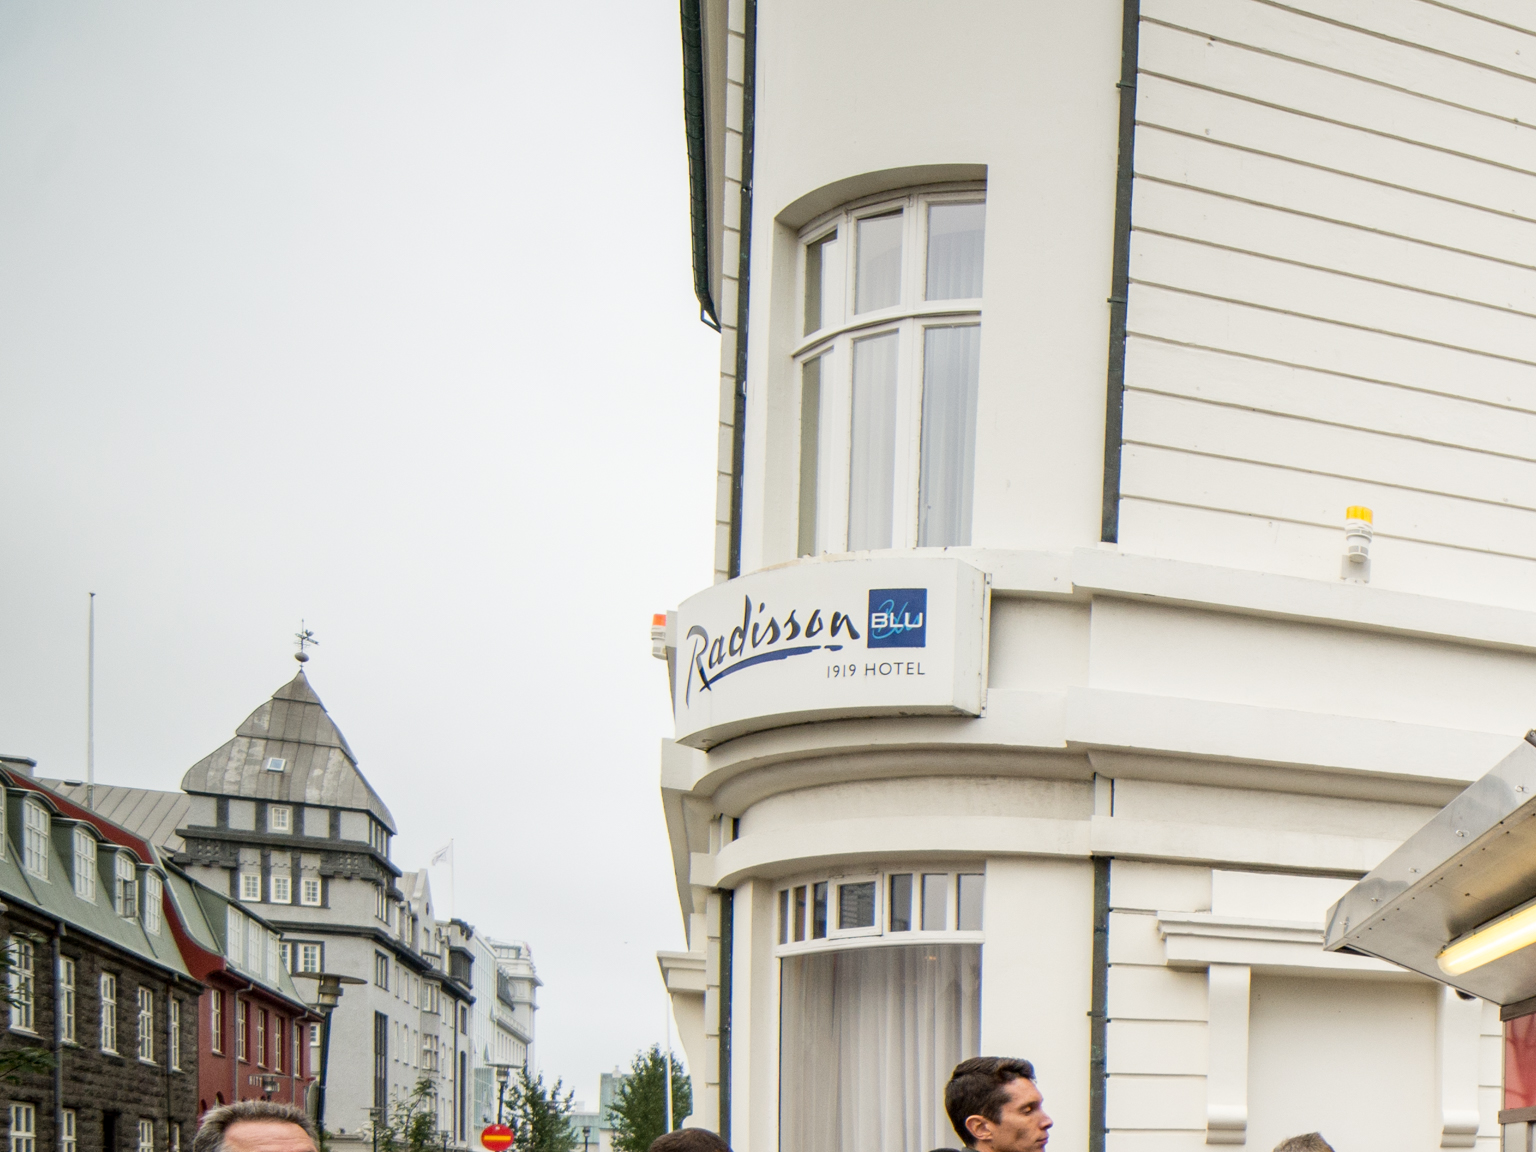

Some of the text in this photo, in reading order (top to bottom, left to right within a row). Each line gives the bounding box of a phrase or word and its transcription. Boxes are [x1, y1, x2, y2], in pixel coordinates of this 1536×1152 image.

[871, 612, 923, 628] BLU
[685, 594, 860, 709] Radisson
[827, 661, 926, 679] 1919 HOTEL
